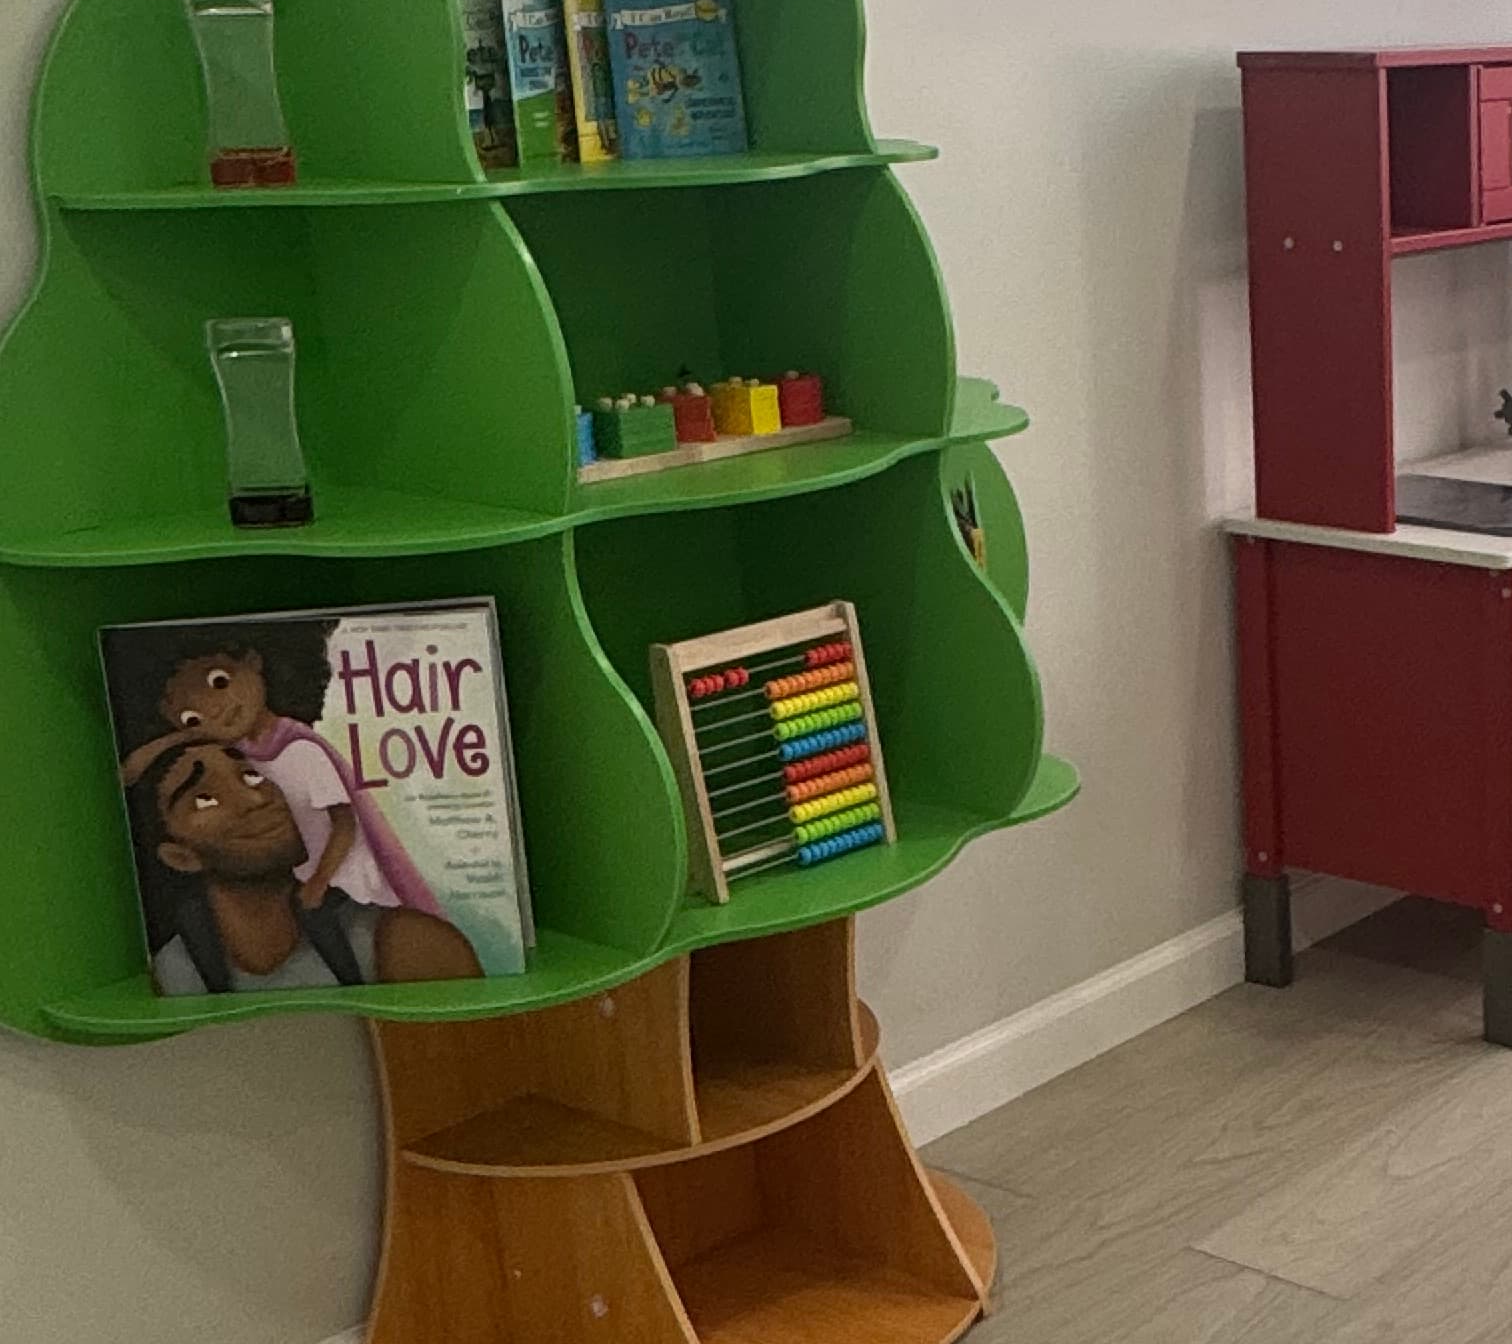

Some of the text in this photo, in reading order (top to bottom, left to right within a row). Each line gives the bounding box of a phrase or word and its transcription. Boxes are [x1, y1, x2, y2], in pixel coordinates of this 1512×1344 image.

[518, 34, 554, 65] Pete
[623, 31, 675, 59] Pete
[338, 639, 483, 717] Hair
[348, 716, 491, 791] Love
